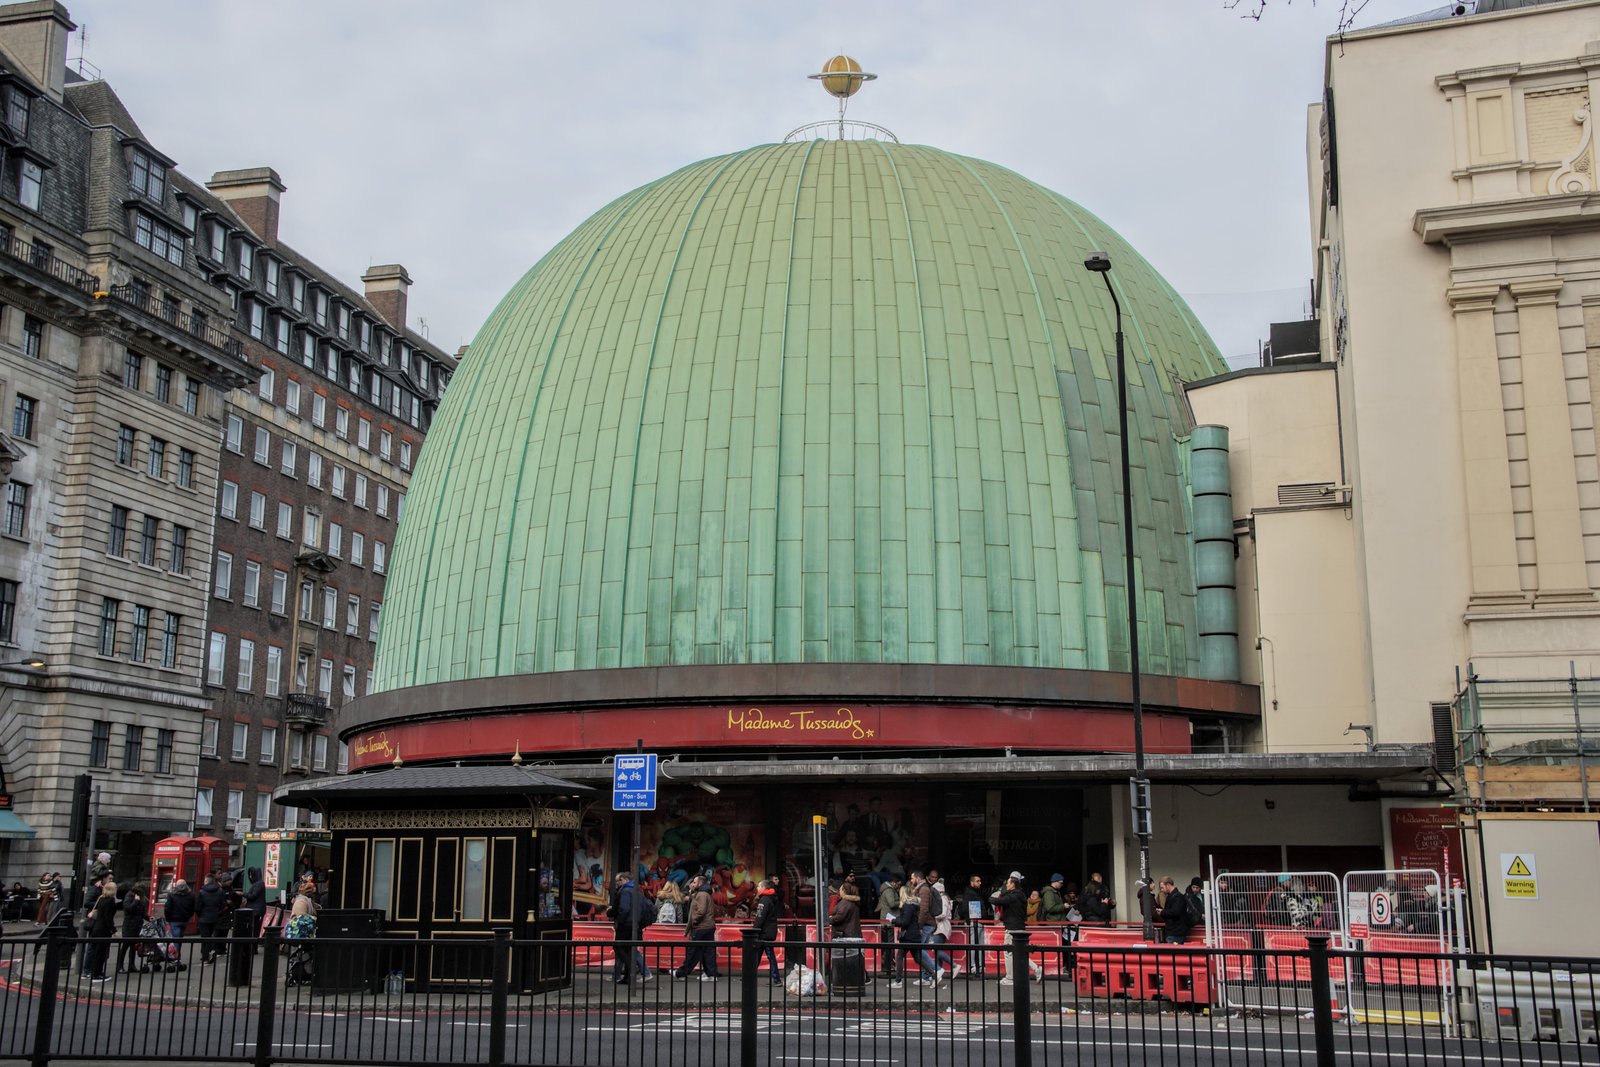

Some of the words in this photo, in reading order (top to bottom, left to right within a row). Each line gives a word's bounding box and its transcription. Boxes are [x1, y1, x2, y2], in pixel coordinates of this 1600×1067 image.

[728, 708, 794, 732] Madame
[790, 708, 865, 739] Tussauds
[1395, 813, 1431, 824] Madame
[1376, 897, 1384, 915] 5
